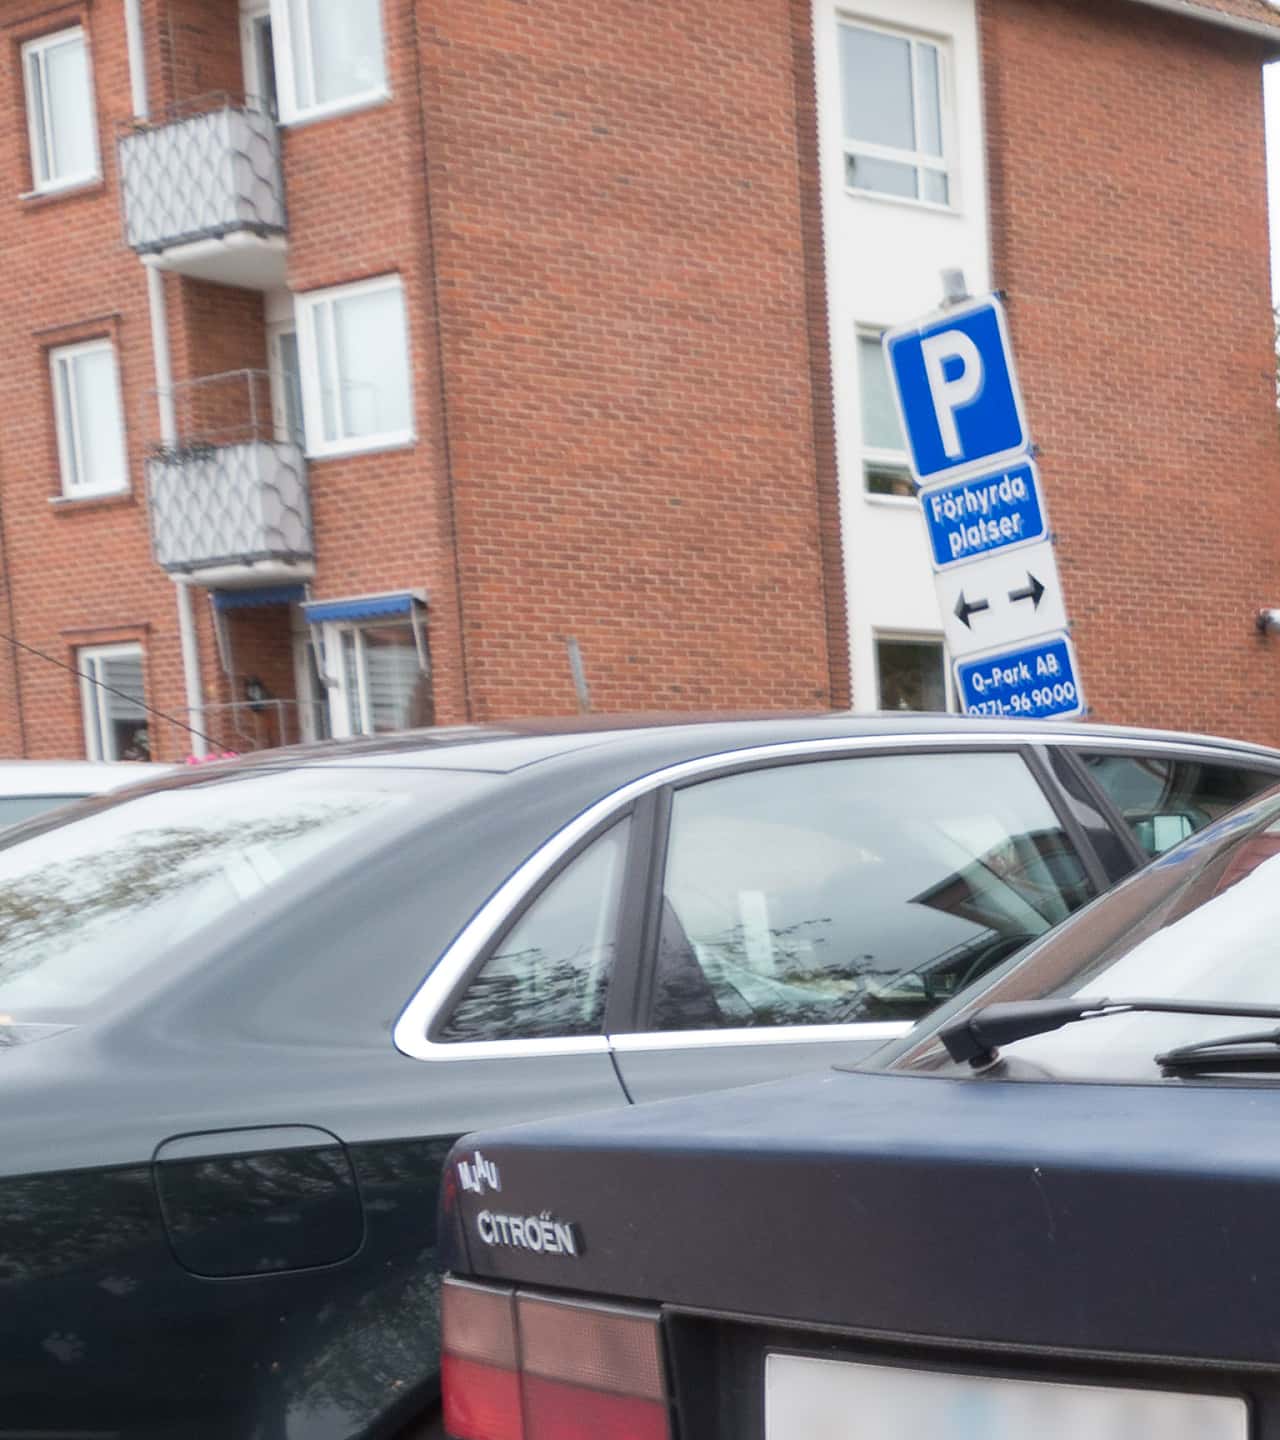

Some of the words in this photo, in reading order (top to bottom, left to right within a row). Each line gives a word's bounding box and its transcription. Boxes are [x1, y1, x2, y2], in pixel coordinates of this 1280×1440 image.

[919, 328, 985, 459] P
[931, 473, 1026, 523] Förhyrda
[948, 512, 1021, 558] platser
[972, 661, 1032, 692] Q-Park
[1036, 653, 1059, 676] AB
[477, 1209, 577, 1256] CITROËN
